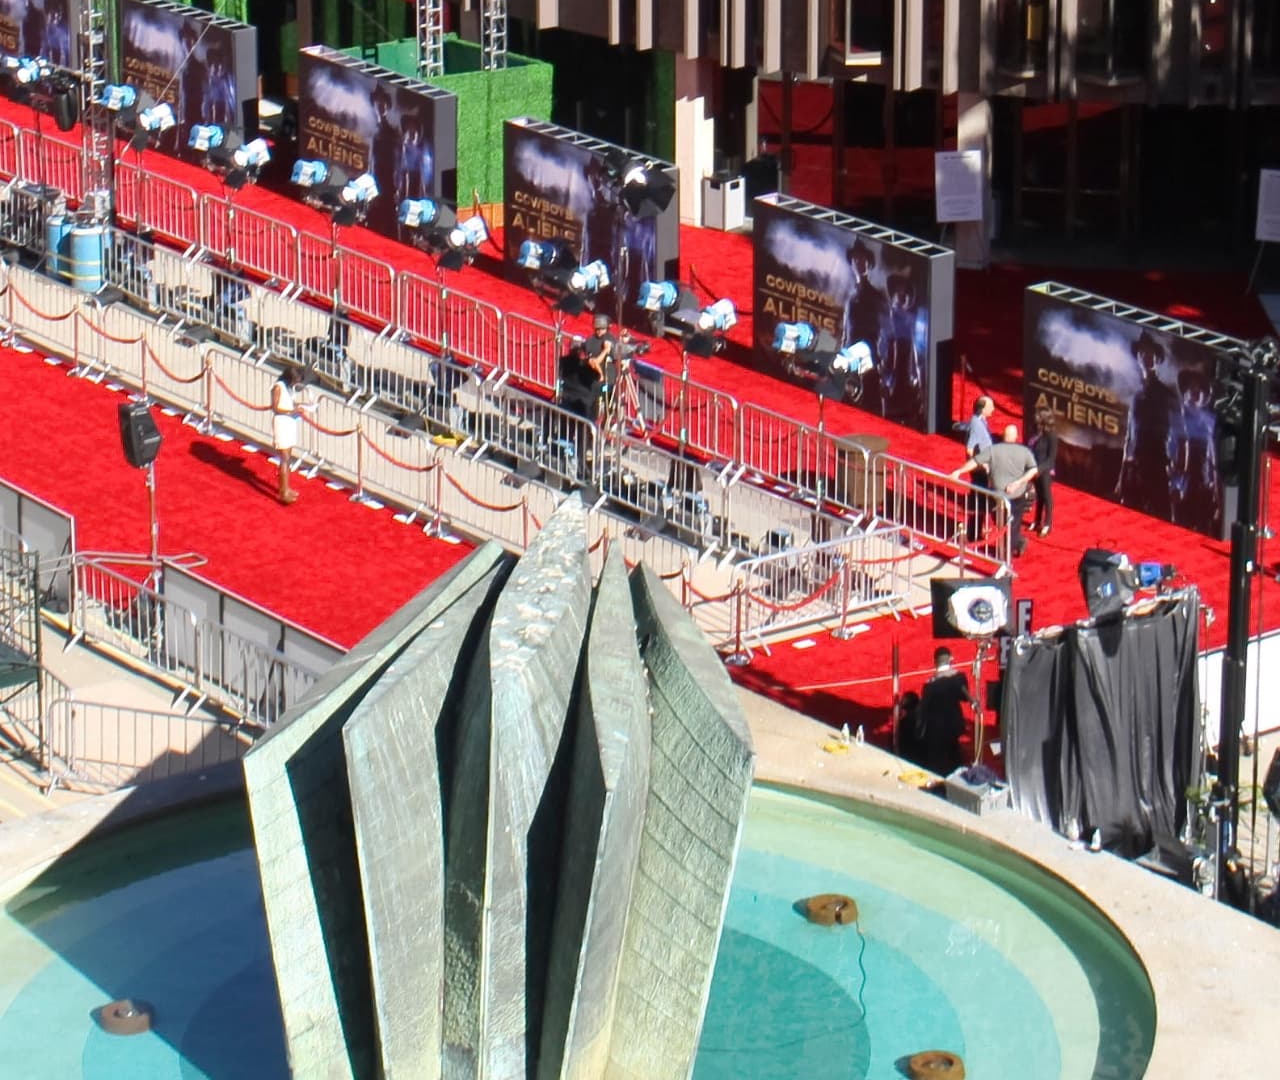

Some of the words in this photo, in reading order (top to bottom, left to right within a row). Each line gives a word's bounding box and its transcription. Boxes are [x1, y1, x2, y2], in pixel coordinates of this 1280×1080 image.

[306, 136, 365, 170] ALIENS
[765, 273, 837, 307] COWBOYS
[1037, 367, 1118, 403] COWBOYS
[1035, 392, 1120, 436] ALIENS
